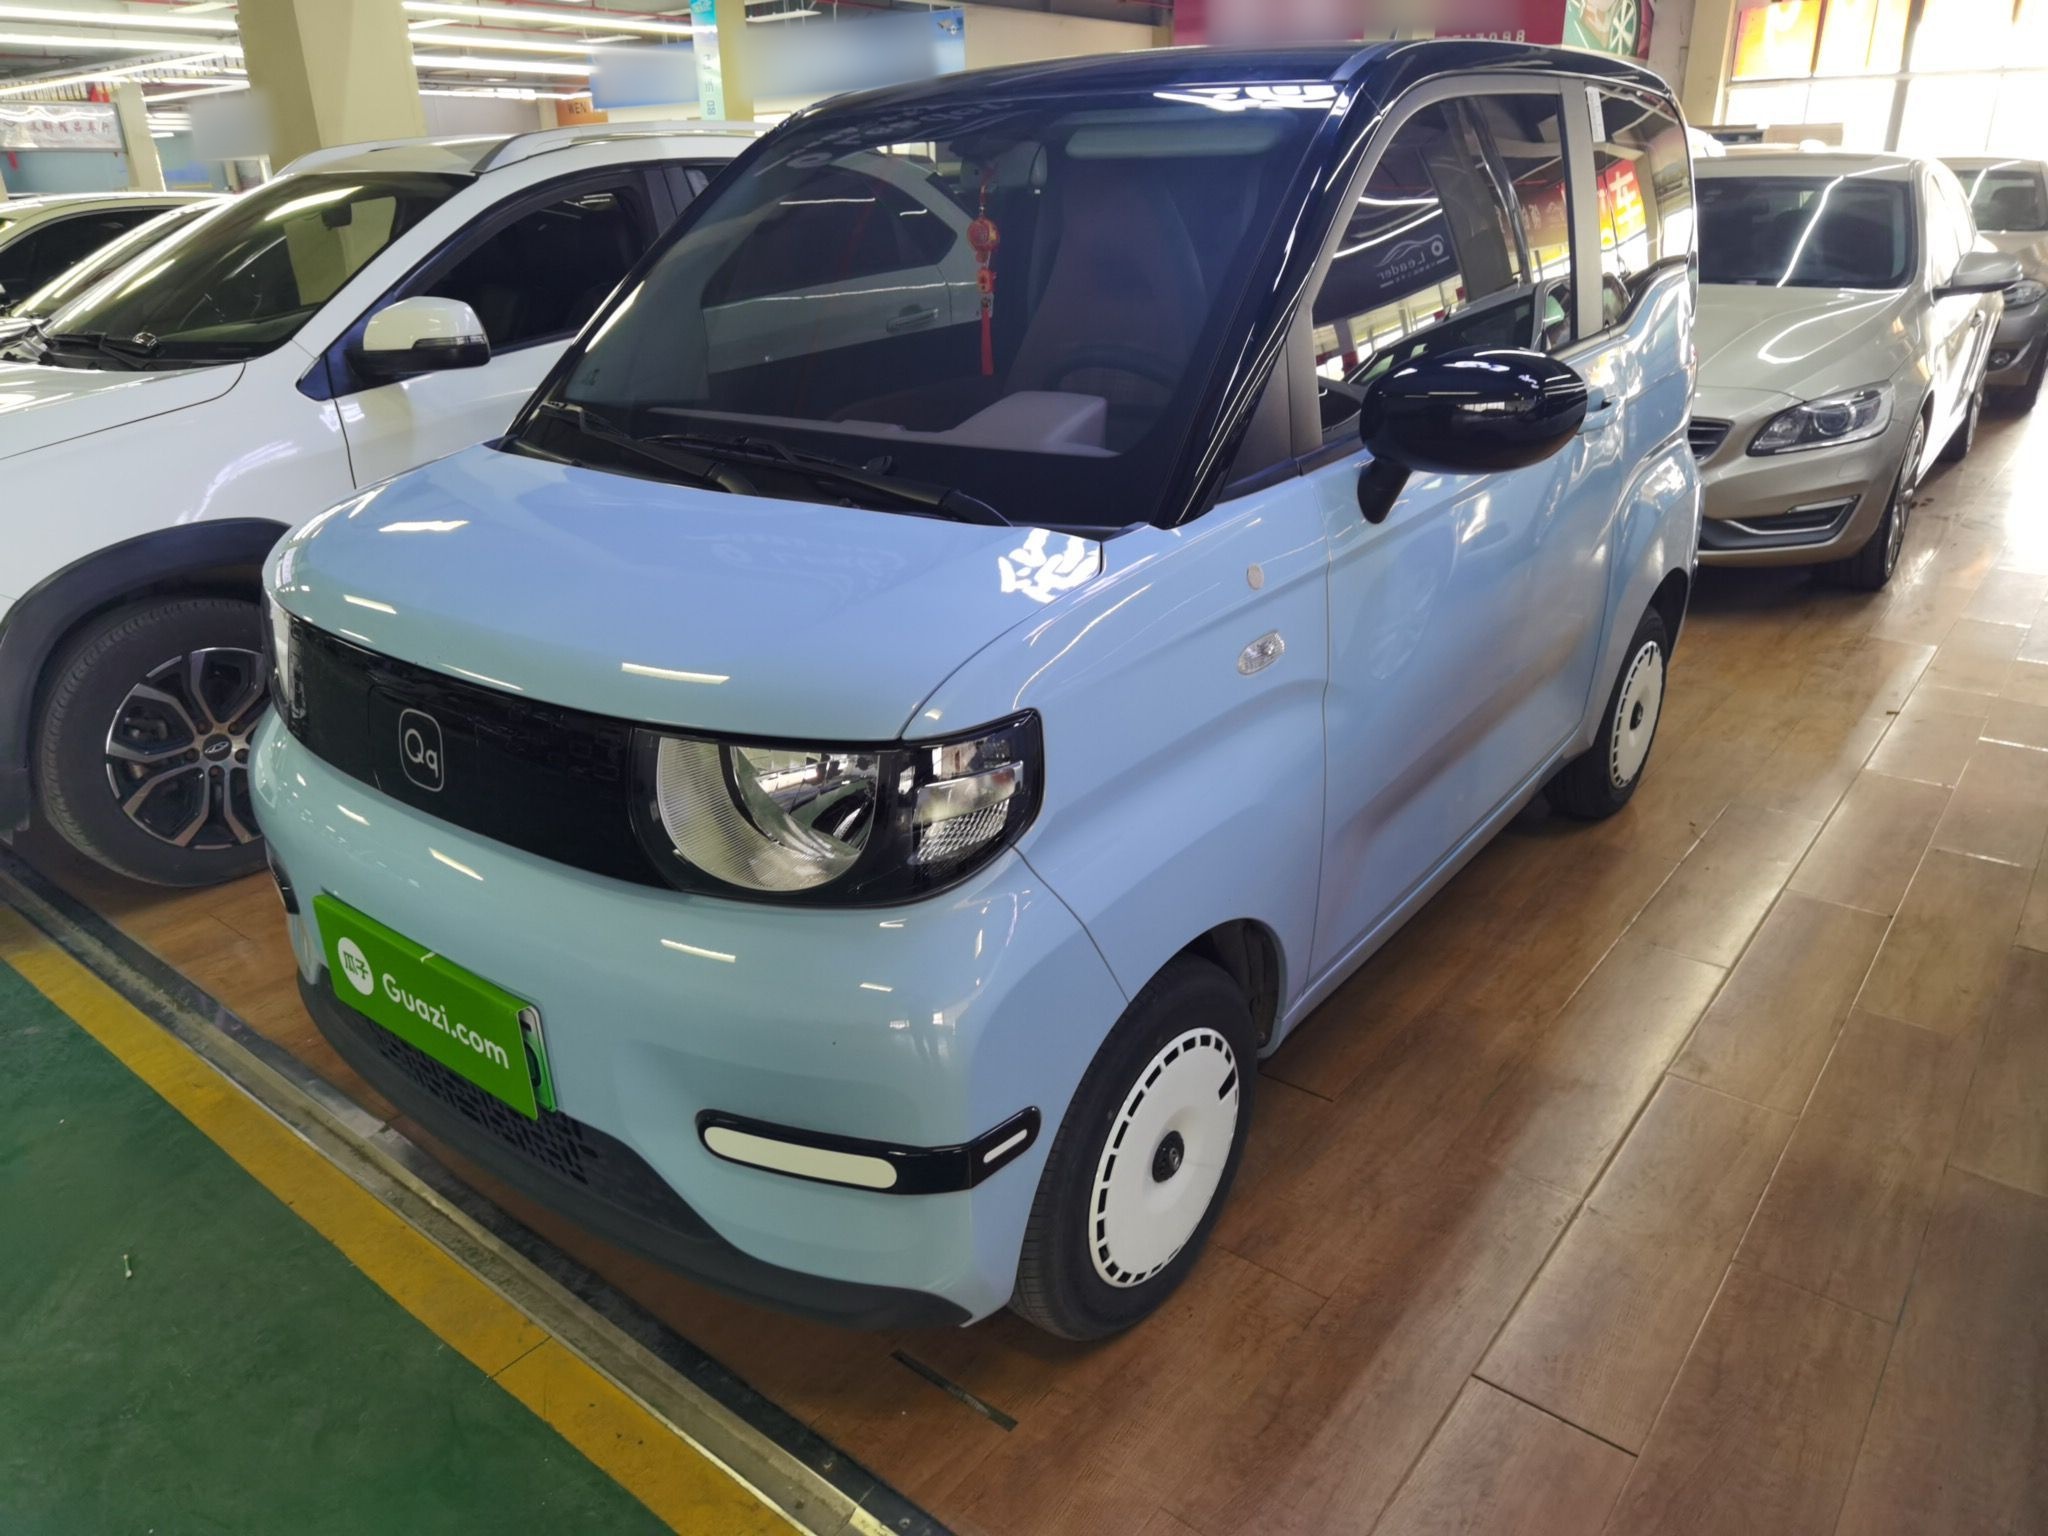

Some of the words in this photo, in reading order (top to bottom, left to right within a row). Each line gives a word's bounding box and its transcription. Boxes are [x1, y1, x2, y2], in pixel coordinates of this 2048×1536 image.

[404, 728, 439, 779] Qq
[343, 951, 369, 980] 瓜子
[382, 972, 510, 1070] Guazi.com
